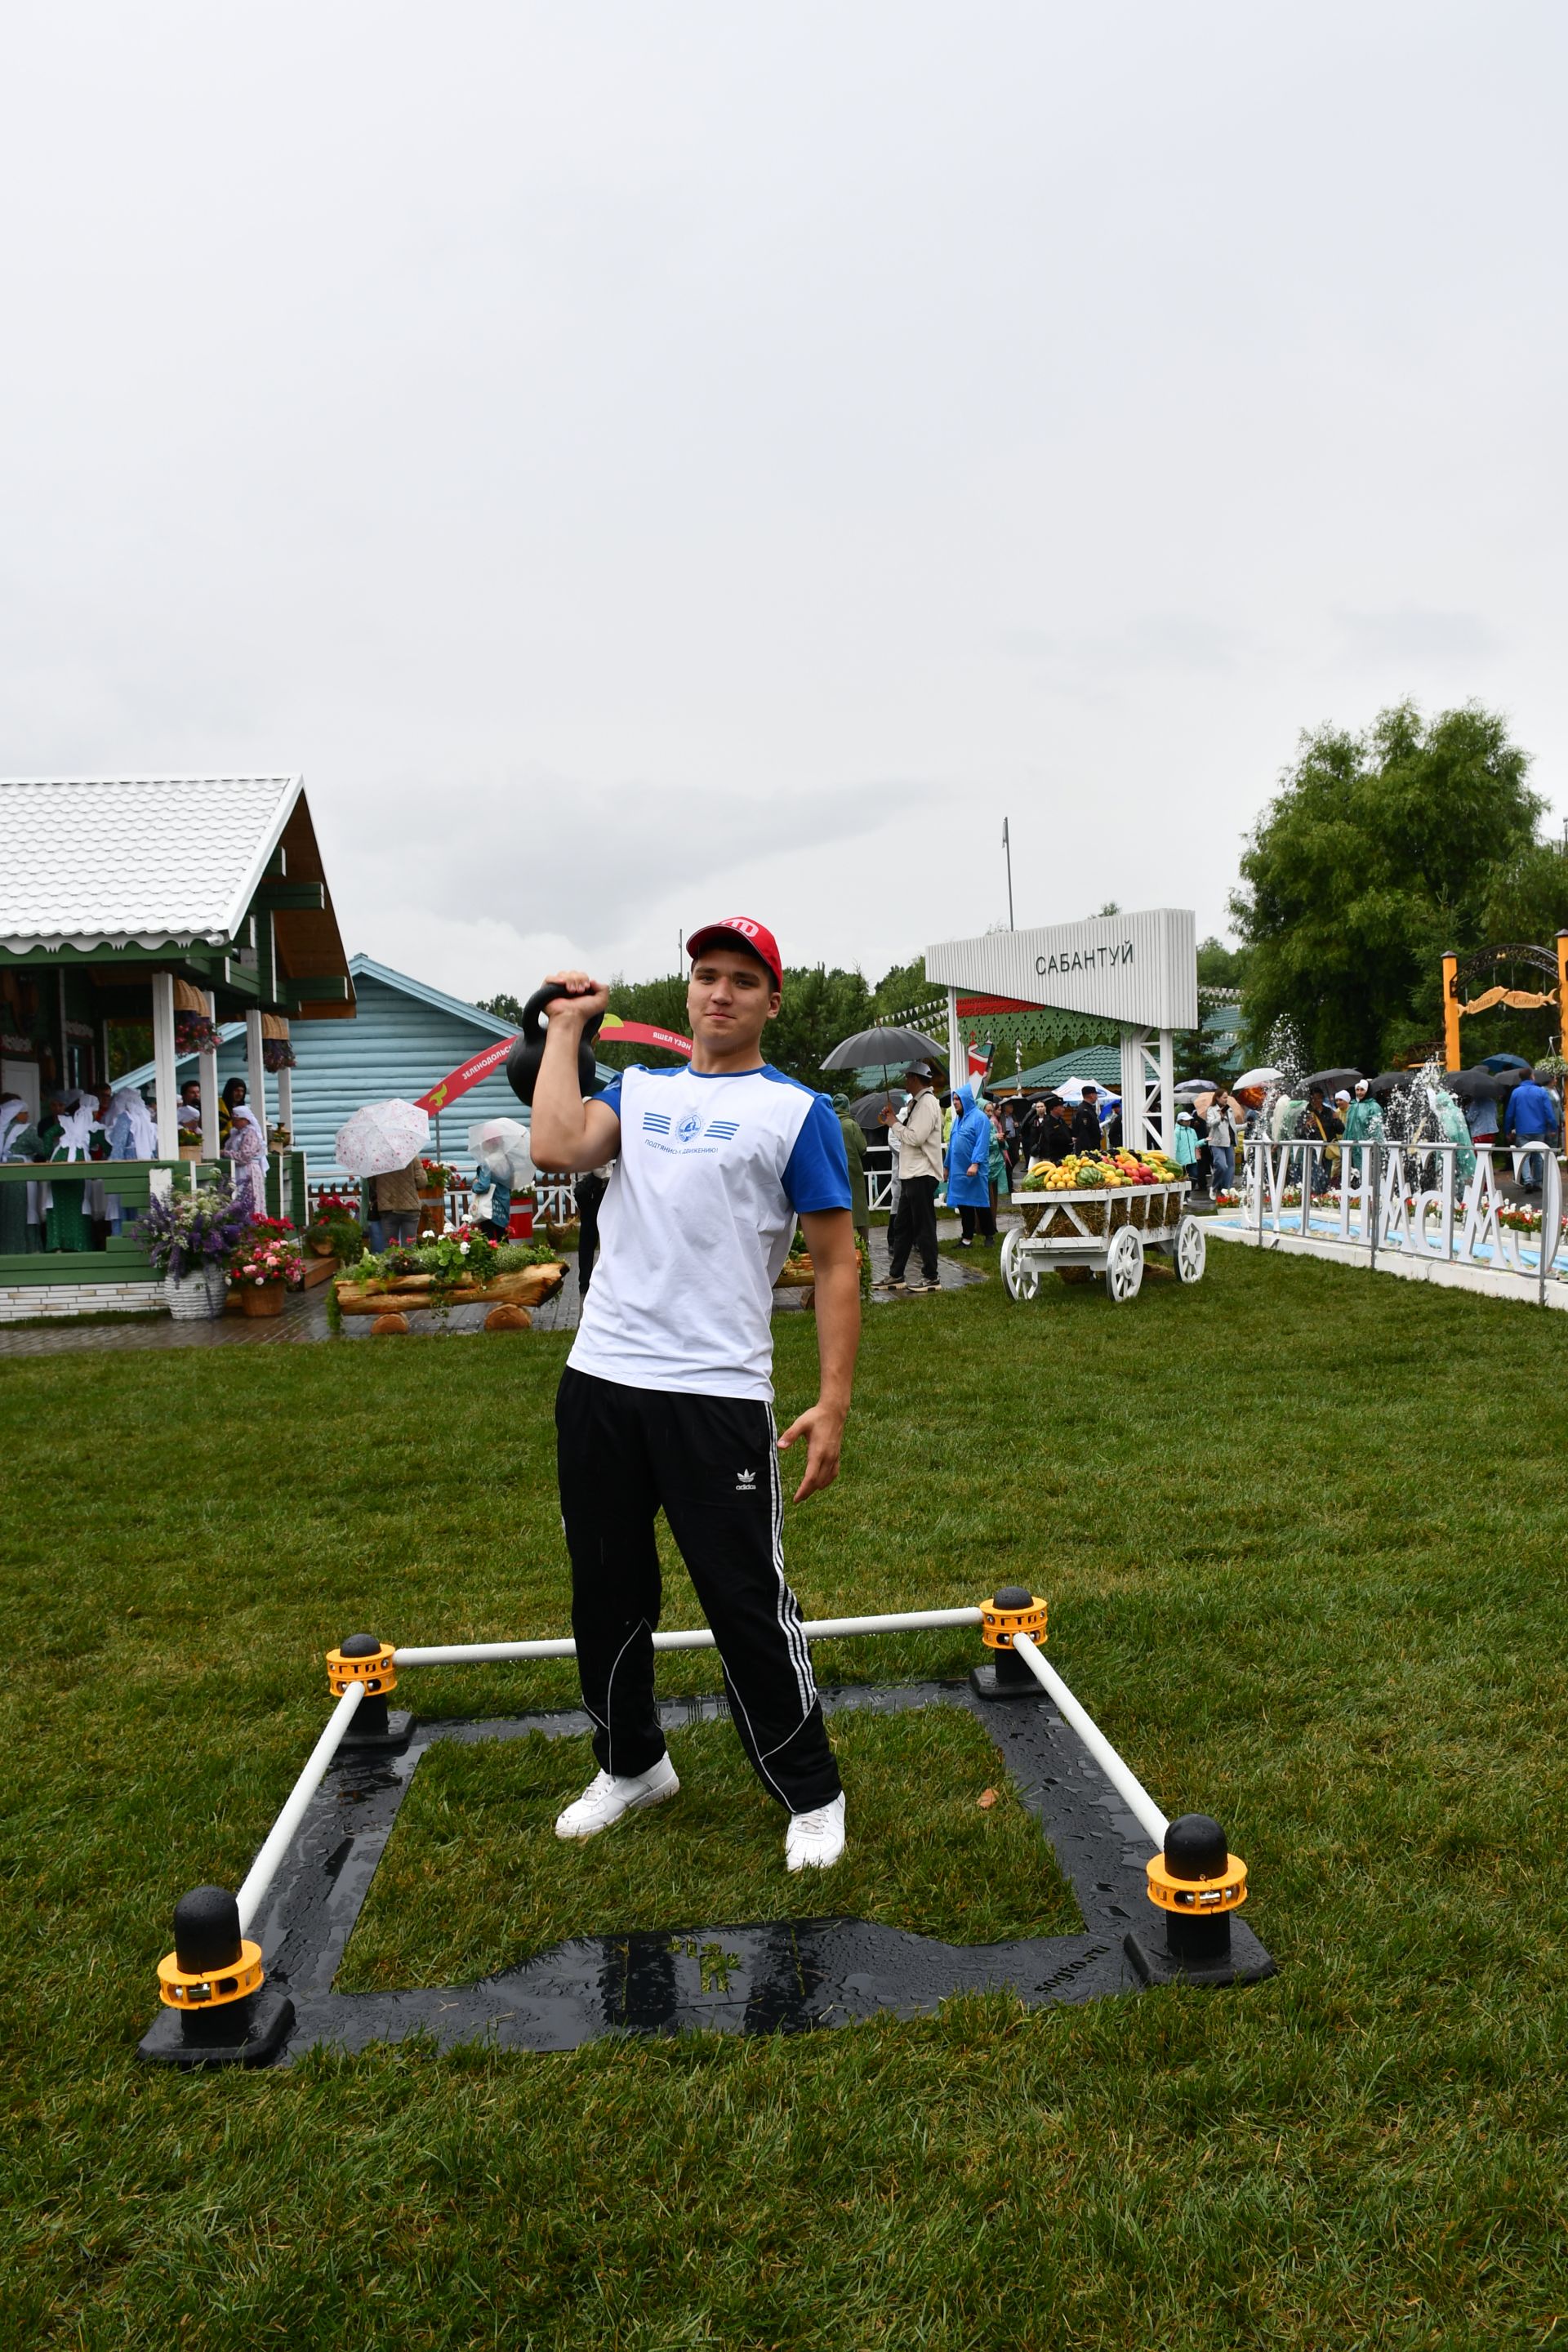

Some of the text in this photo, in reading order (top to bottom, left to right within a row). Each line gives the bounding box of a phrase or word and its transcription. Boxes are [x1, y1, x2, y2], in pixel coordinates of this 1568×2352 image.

[1036, 940, 1133, 975] САБАНТУЙ
[653, 1031, 673, 1043] ЯШЕЛ
[682, 1147, 719, 1155] ДВИЖЕНИЮ!
[1000, 1615, 1036, 1626] ГТО
[339, 1663, 376, 1673] ГТО
[1034, 1944, 1111, 1994] sogto.ru
